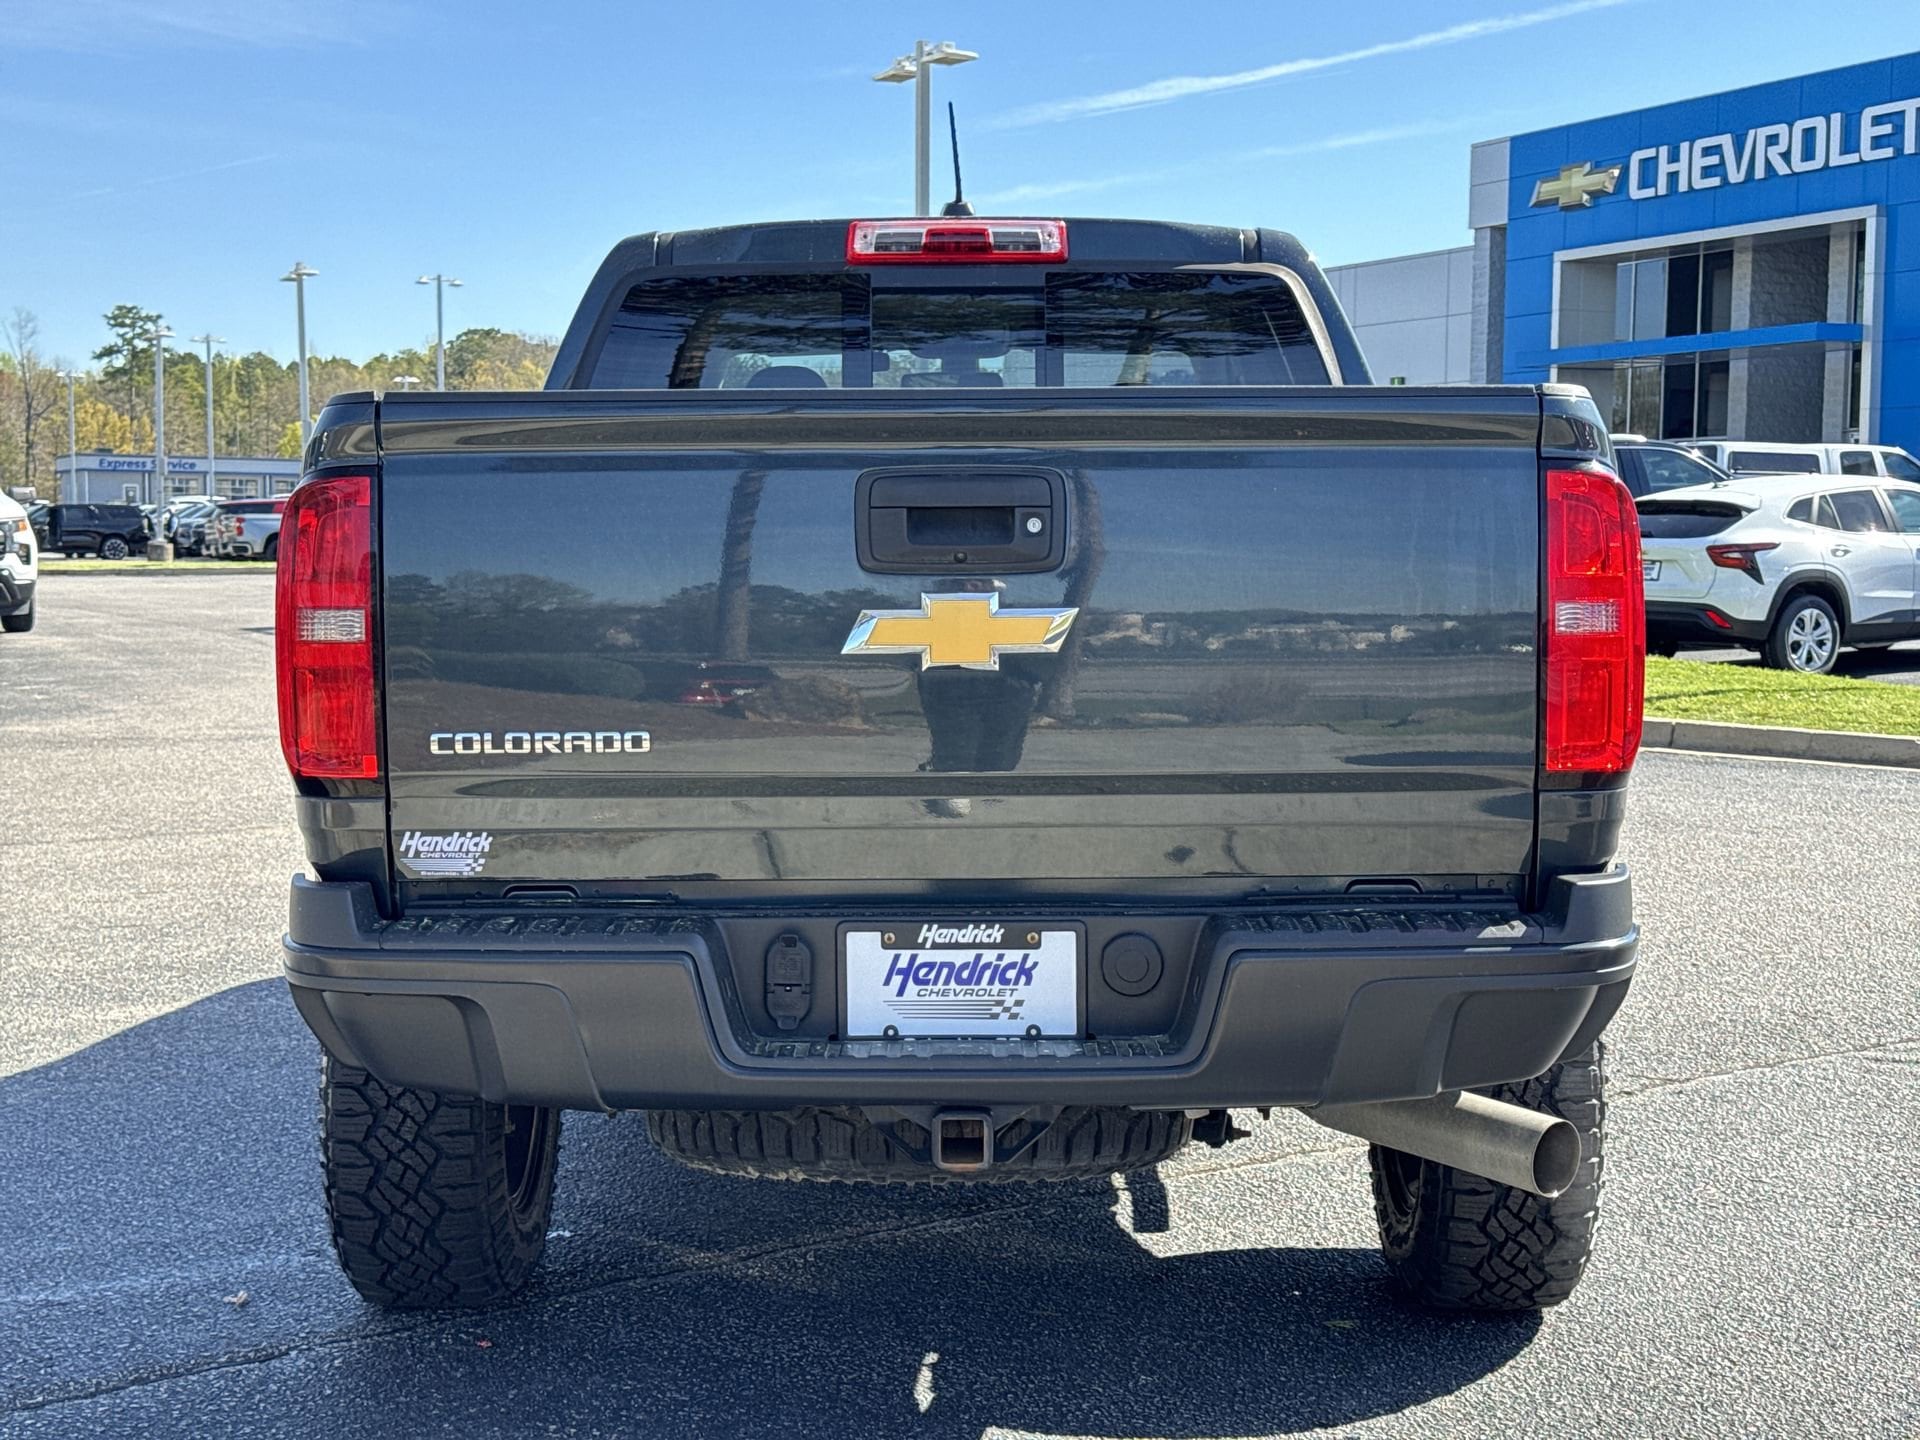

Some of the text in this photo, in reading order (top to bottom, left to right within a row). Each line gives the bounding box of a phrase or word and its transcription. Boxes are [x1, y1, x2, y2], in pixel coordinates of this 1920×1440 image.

[1628, 97, 1920, 200] CHEVROLET
[99, 459, 197, 470] Express Srvice
[430, 731, 651, 755] COLORADO
[399, 831, 493, 858] Hendrick
[917, 924, 1005, 949] Hendrick
[882, 953, 1039, 998] Hendrick
[916, 988, 1019, 998] CHEVROLET
